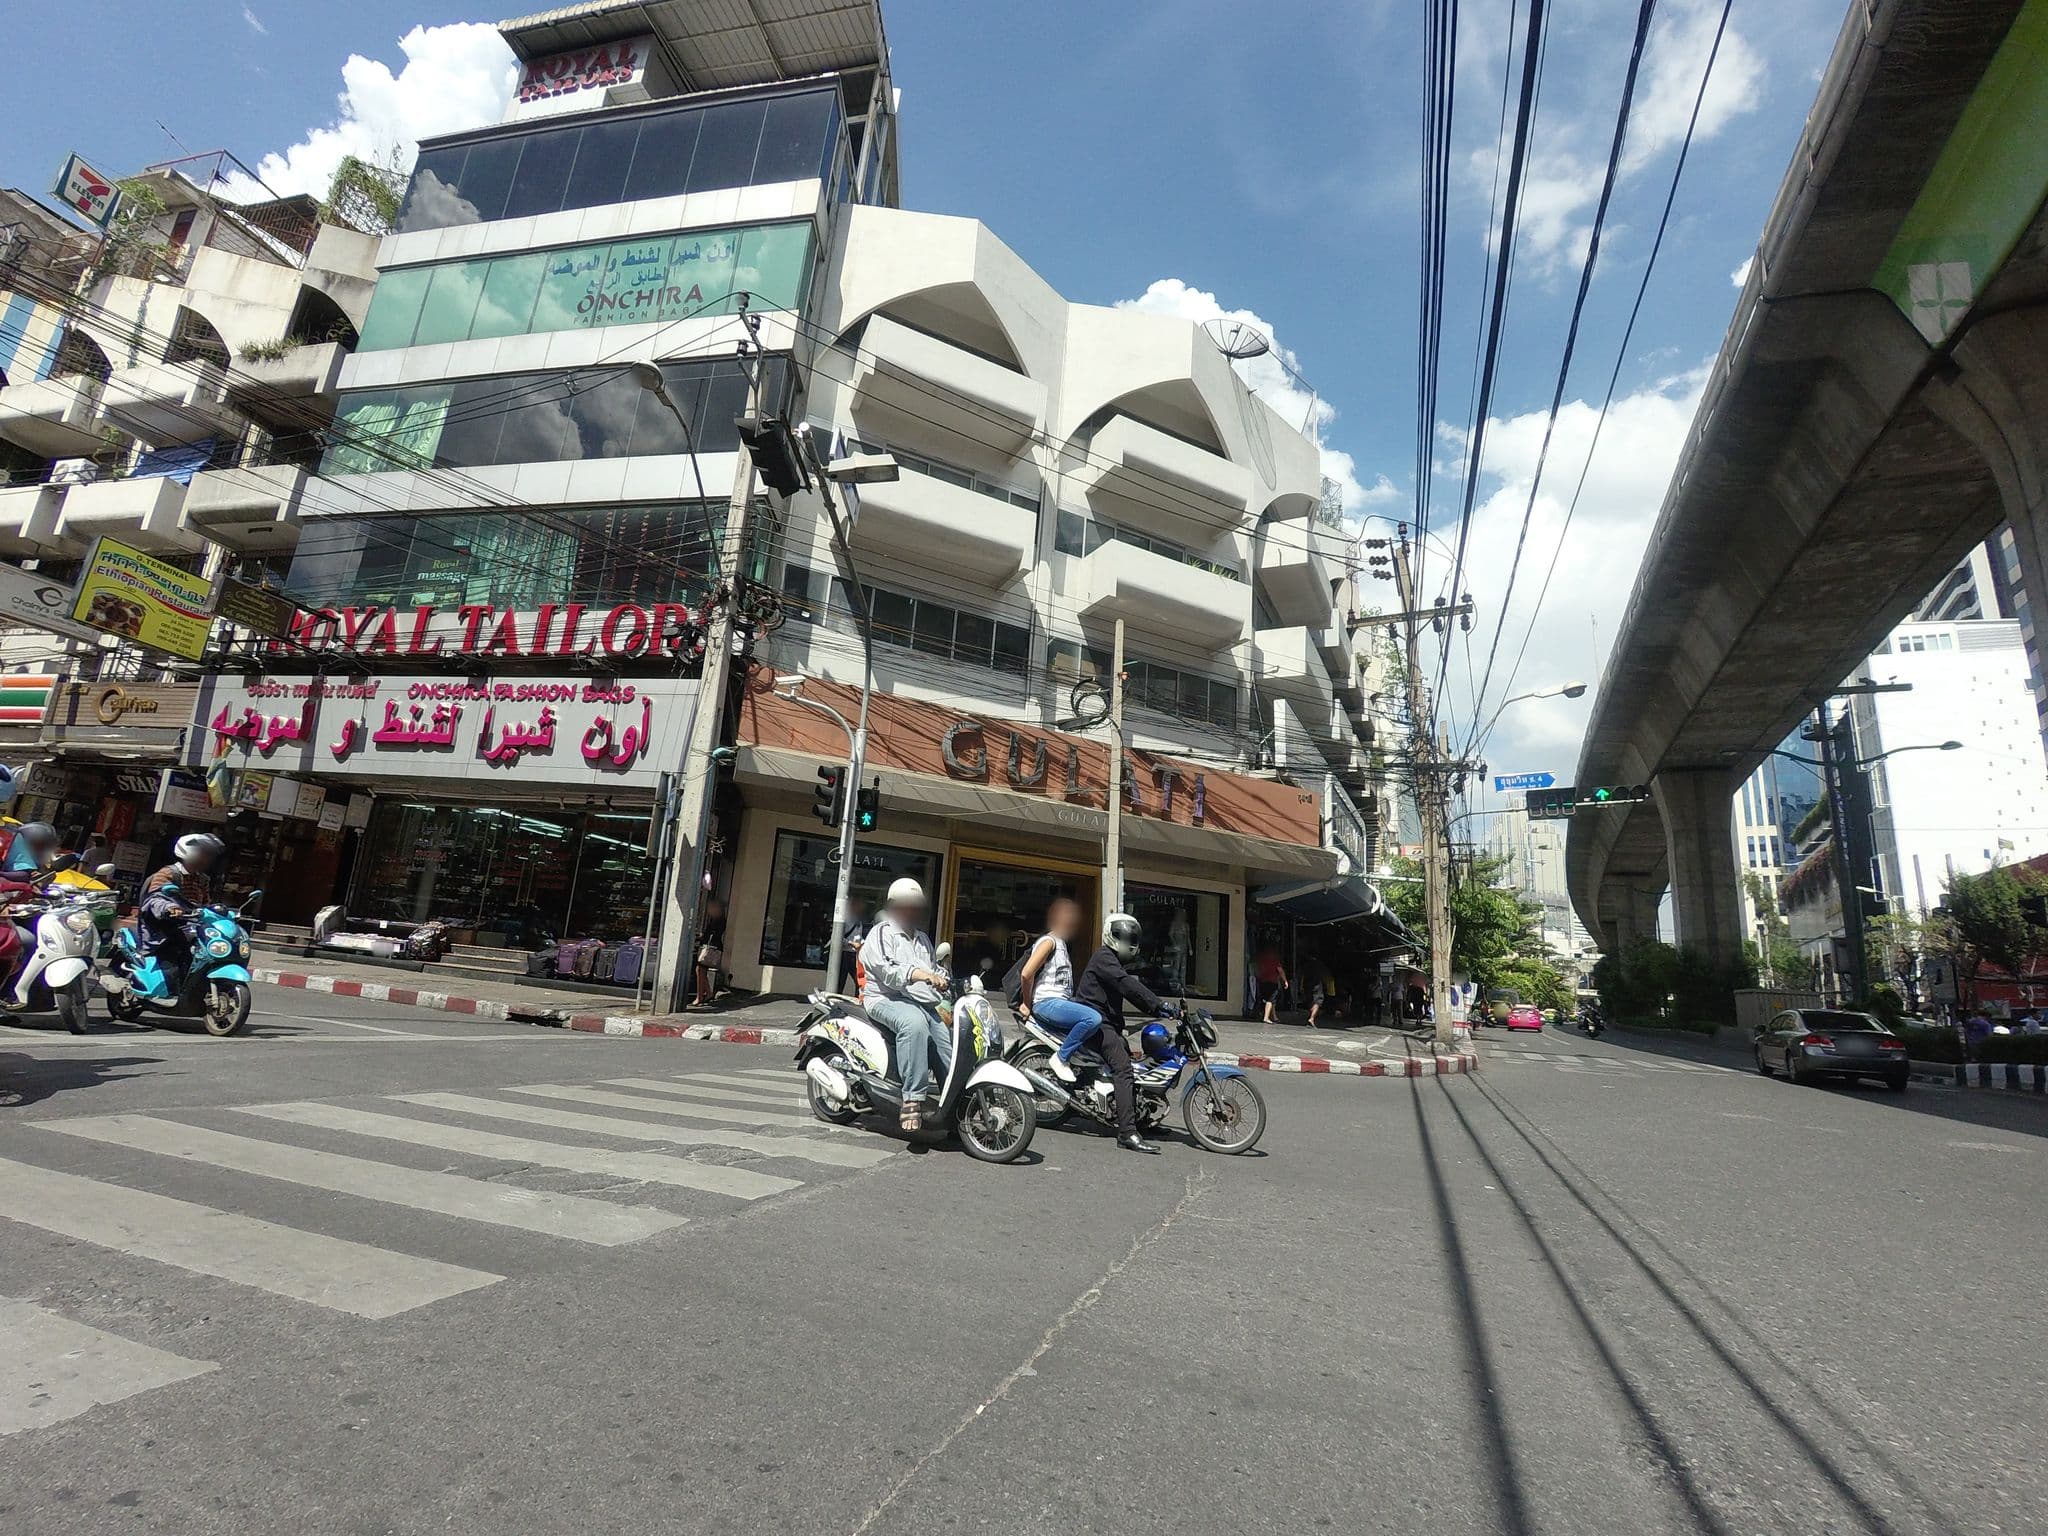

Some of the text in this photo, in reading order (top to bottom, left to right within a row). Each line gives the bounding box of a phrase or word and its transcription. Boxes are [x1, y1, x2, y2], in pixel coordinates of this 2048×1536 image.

[522, 41, 638, 86] ROYAL
[519, 63, 633, 104] TAILORS
[576, 283, 704, 314] ONCHIRA
[573, 309, 648, 325] FASHION
[96, 564, 151, 594] Ethiopian
[417, 571, 469, 584] massage
[458, 602, 705, 657] TAILOR
[407, 683, 637, 704] ONCHIRA FASHION BAGS
[330, 718, 357, 755] و
[580, 696, 651, 766] أون
[941, 719, 1205, 822] GULATI
[827, 846, 885, 868] GLATI
